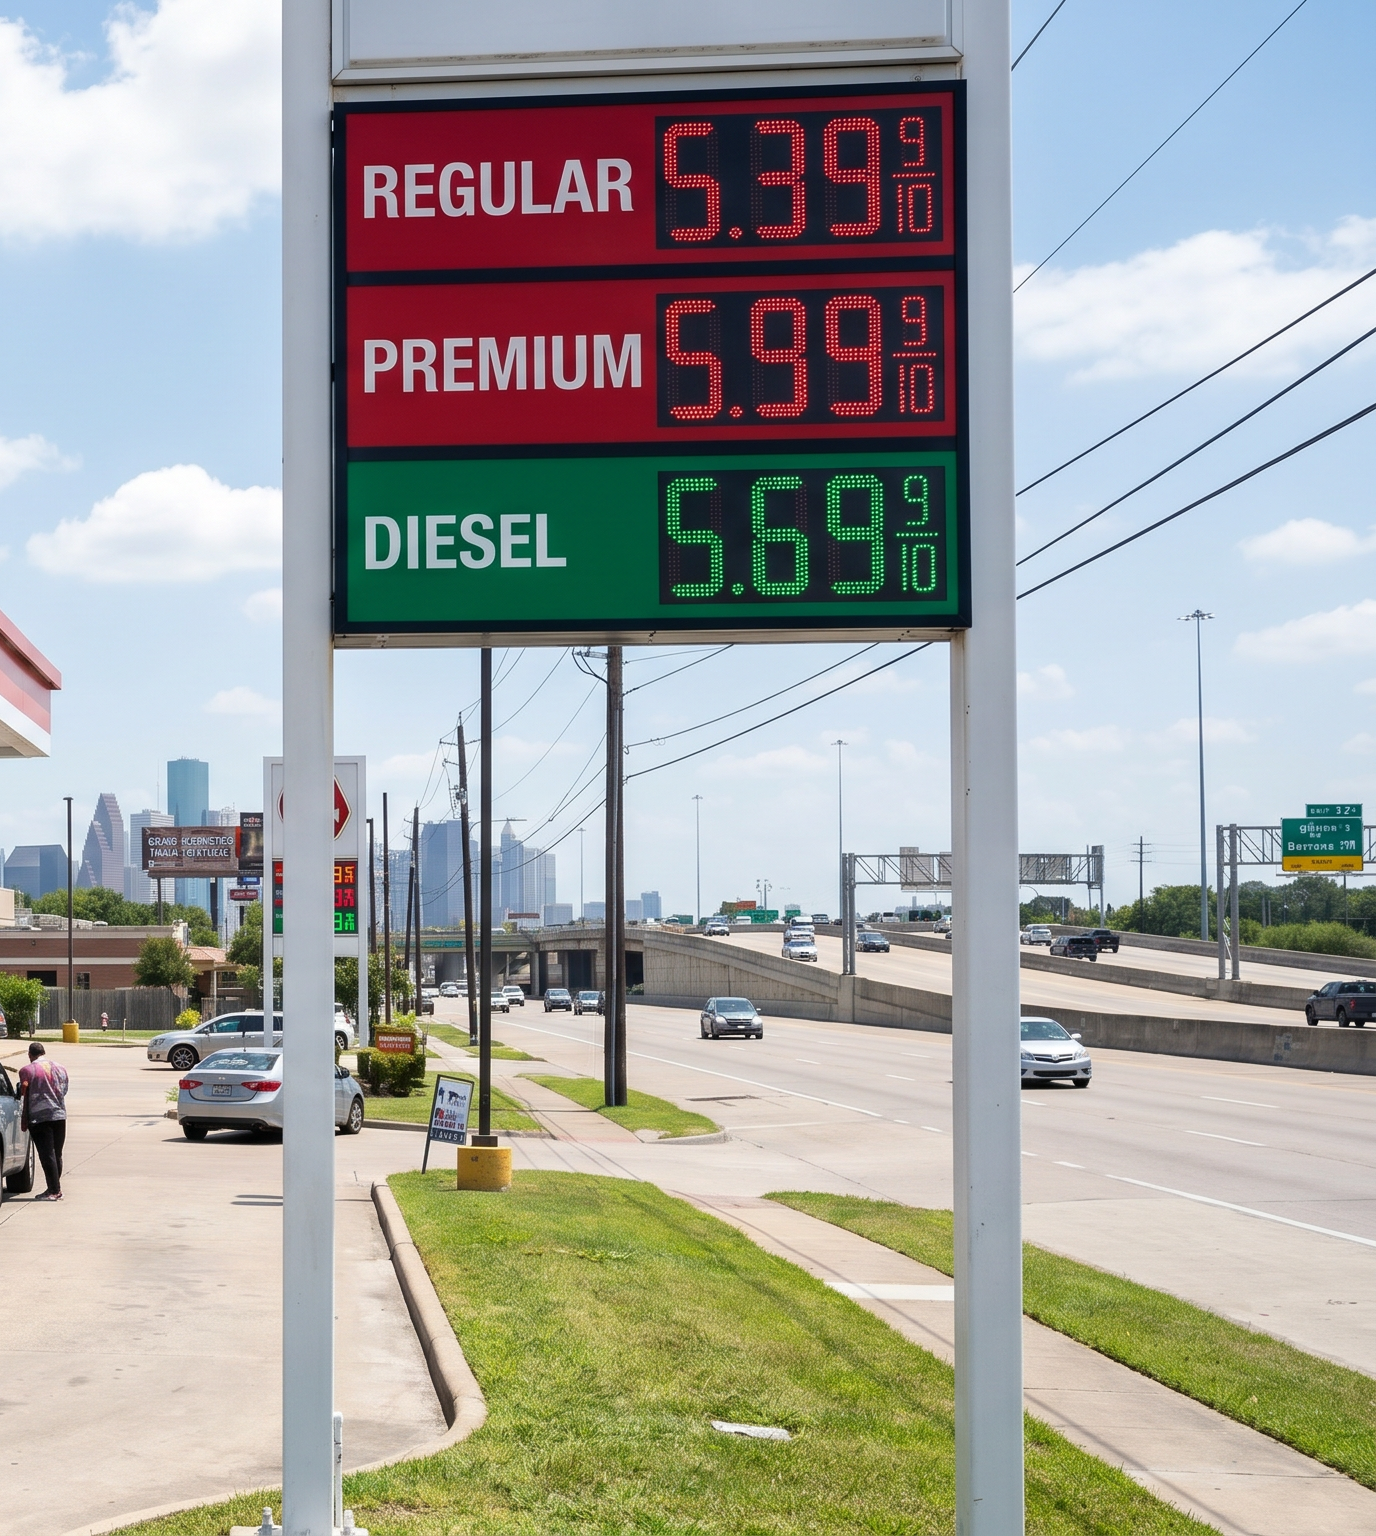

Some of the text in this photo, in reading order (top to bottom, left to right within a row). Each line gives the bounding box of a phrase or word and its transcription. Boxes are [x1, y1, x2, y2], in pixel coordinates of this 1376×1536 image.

[363, 158, 634, 219] REGULAR
[664, 117, 882, 242] 5.39
[364, 333, 643, 393] PREMIUM
[665, 296, 884, 420] 5.99
[365, 513, 567, 570] DIESEL
[666, 474, 886, 598] 5.69
